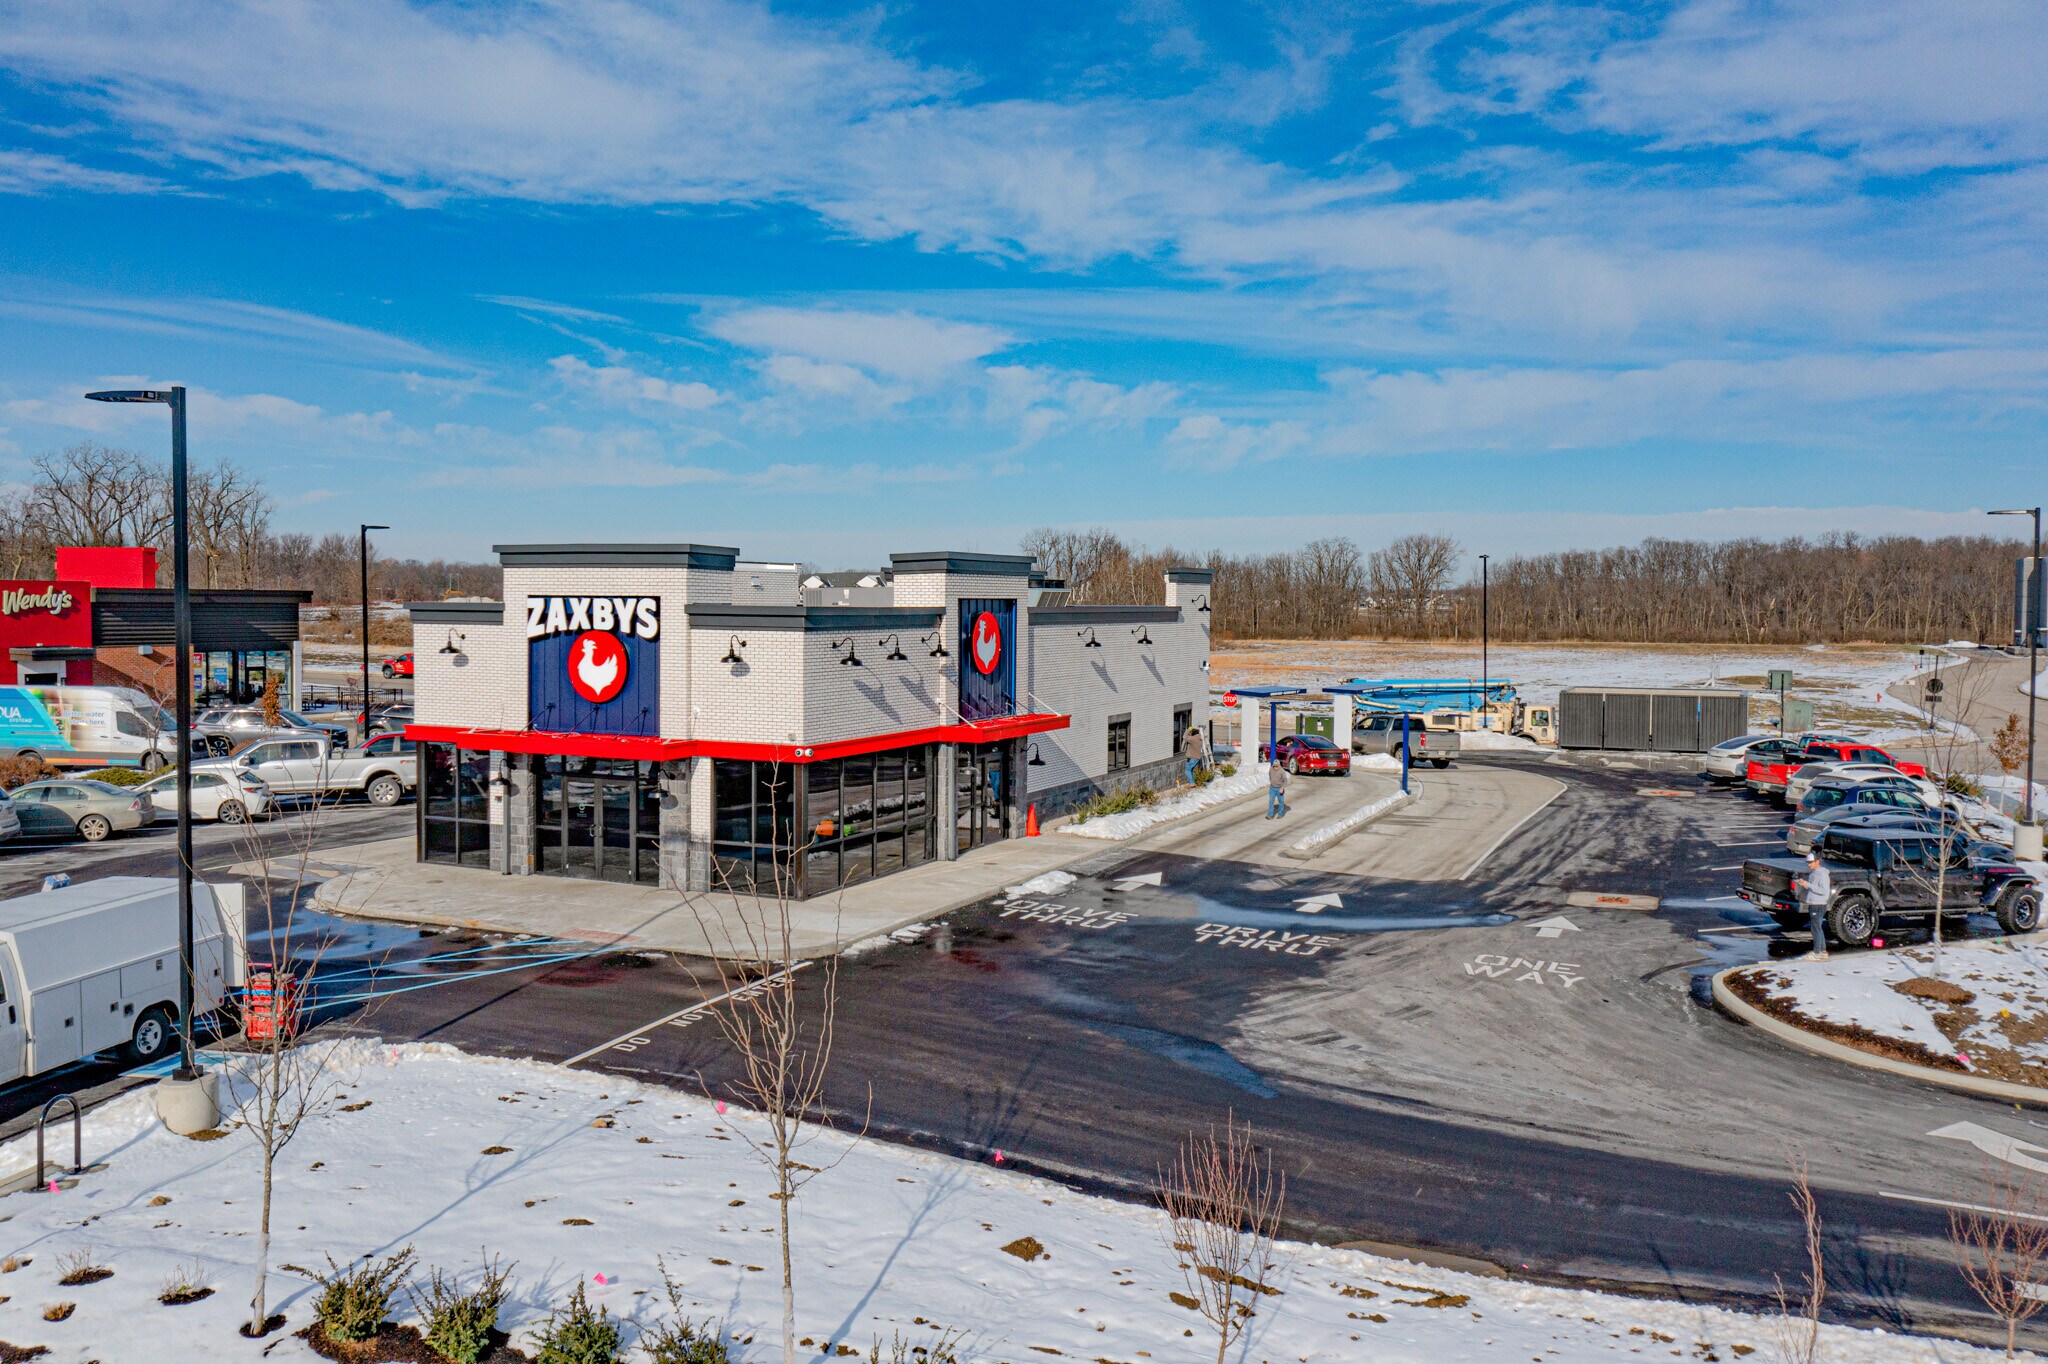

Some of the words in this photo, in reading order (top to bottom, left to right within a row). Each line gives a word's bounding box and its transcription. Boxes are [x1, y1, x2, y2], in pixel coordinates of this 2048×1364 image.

[2, 585, 73, 615] Wendy's
[527, 597, 659, 639] ZAXBYS
[63, 710, 84, 718] Better
[86, 710, 105, 718] water
[999, 908, 1117, 929] THRU
[1005, 900, 1139, 922] DRIVE
[1195, 923, 1340, 947] DRIVE
[1195, 932, 1322, 956] THRU
[1463, 962, 1586, 988] WAY
[1474, 954, 1581, 976] ONE
[612, 1037, 651, 1052] DO
[668, 1008, 715, 1027] NOT
